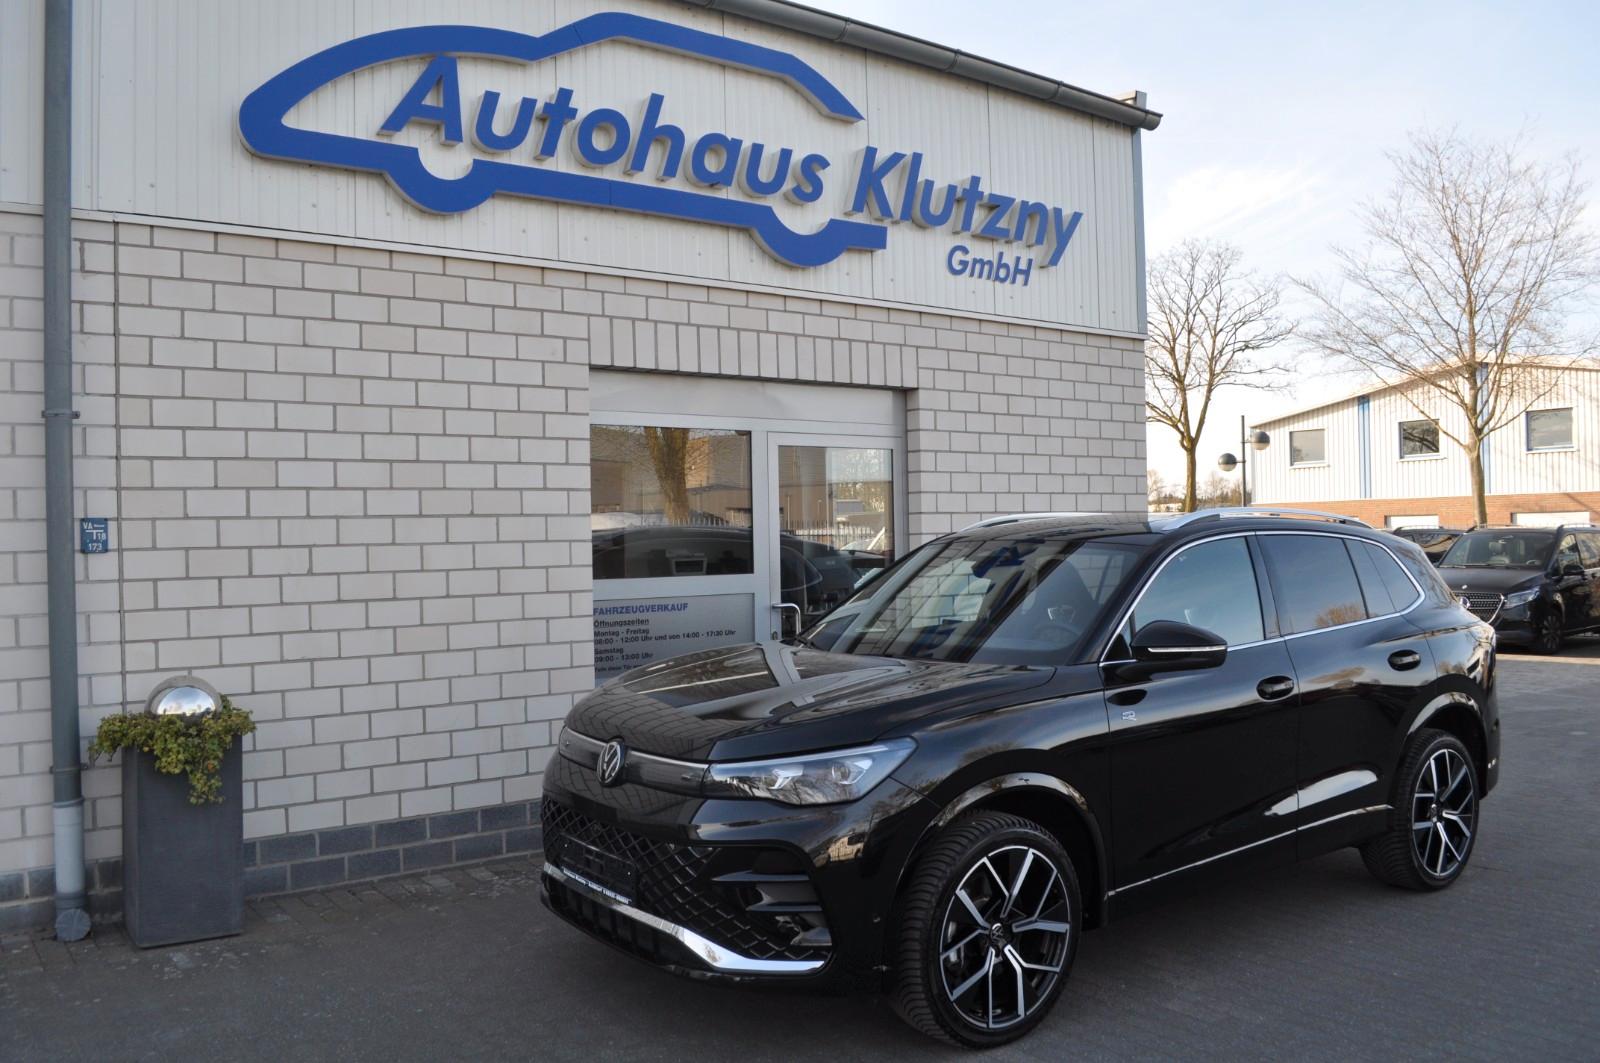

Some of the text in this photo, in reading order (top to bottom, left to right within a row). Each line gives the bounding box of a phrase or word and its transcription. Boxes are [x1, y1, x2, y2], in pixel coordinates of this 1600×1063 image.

[377, 55, 1084, 269] Autohaus Klutzny
[947, 245, 1033, 286] GmbH
[593, 603, 688, 615] FAHRZEUGVERKAUF
[594, 618, 650, 629] Öffnungszeiten
[594, 630, 620, 638] Montag
[625, 628, 650, 636] Freitag
[641, 634, 653, 642] Uhr
[682, 631, 700, 639] 14:00
